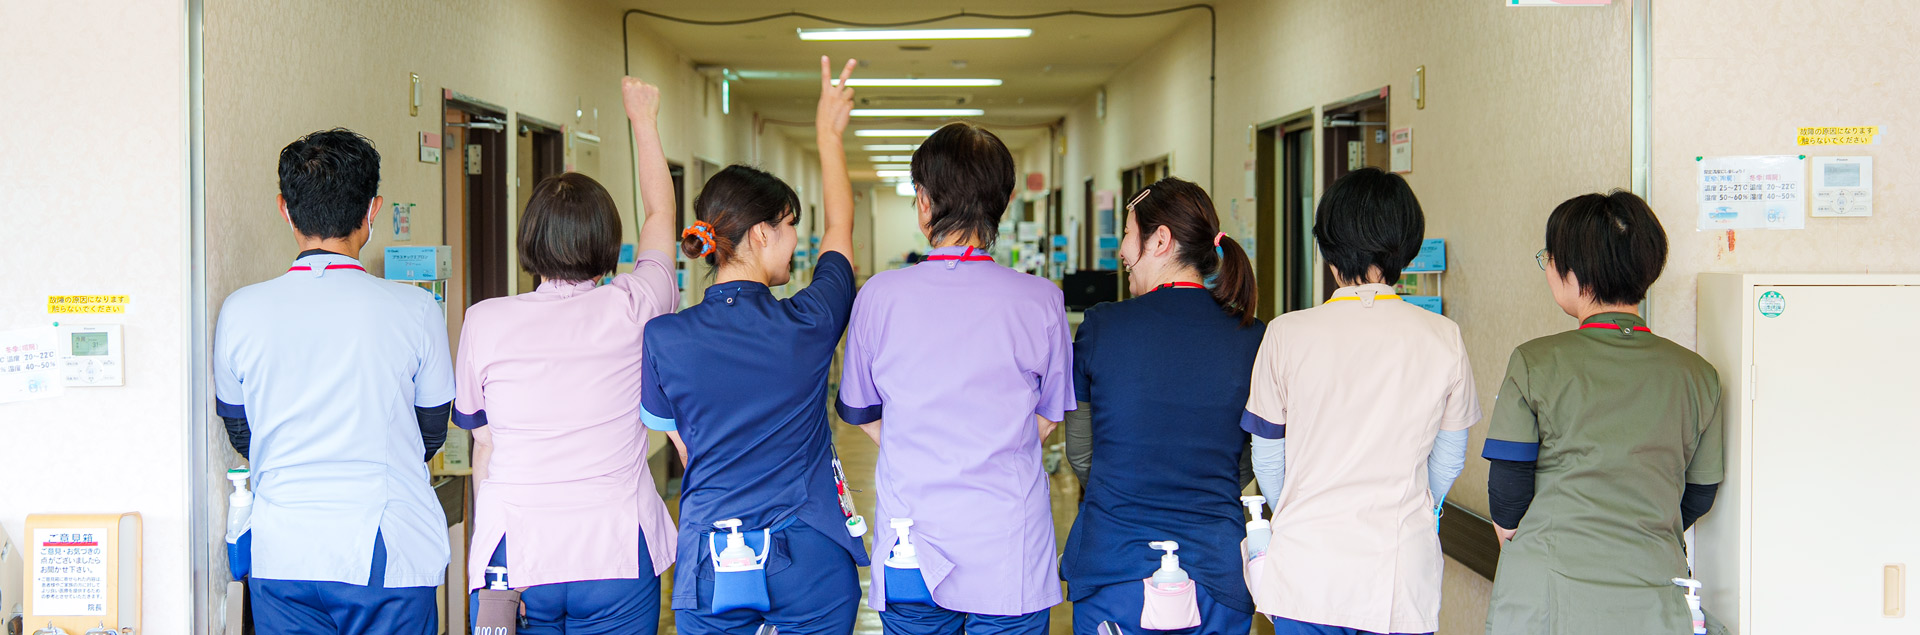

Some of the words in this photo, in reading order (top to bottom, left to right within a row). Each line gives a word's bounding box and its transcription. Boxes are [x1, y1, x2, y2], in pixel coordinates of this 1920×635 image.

[1800, 127, 1873, 136] 故障の原因になります
[1801, 136, 1868, 145] 触らないでください
[1749, 183, 1763, 191] 温度
[49, 296, 125, 304] 故障の原因になります
[48, 533, 93, 544] ご意見箱
[40, 547, 101, 555] ご意見・お気づきの
[40, 556, 101, 564] 点がございましたら
[40, 565, 93, 574] お聞かせ下さい。
[87, 603, 102, 612] 院長
